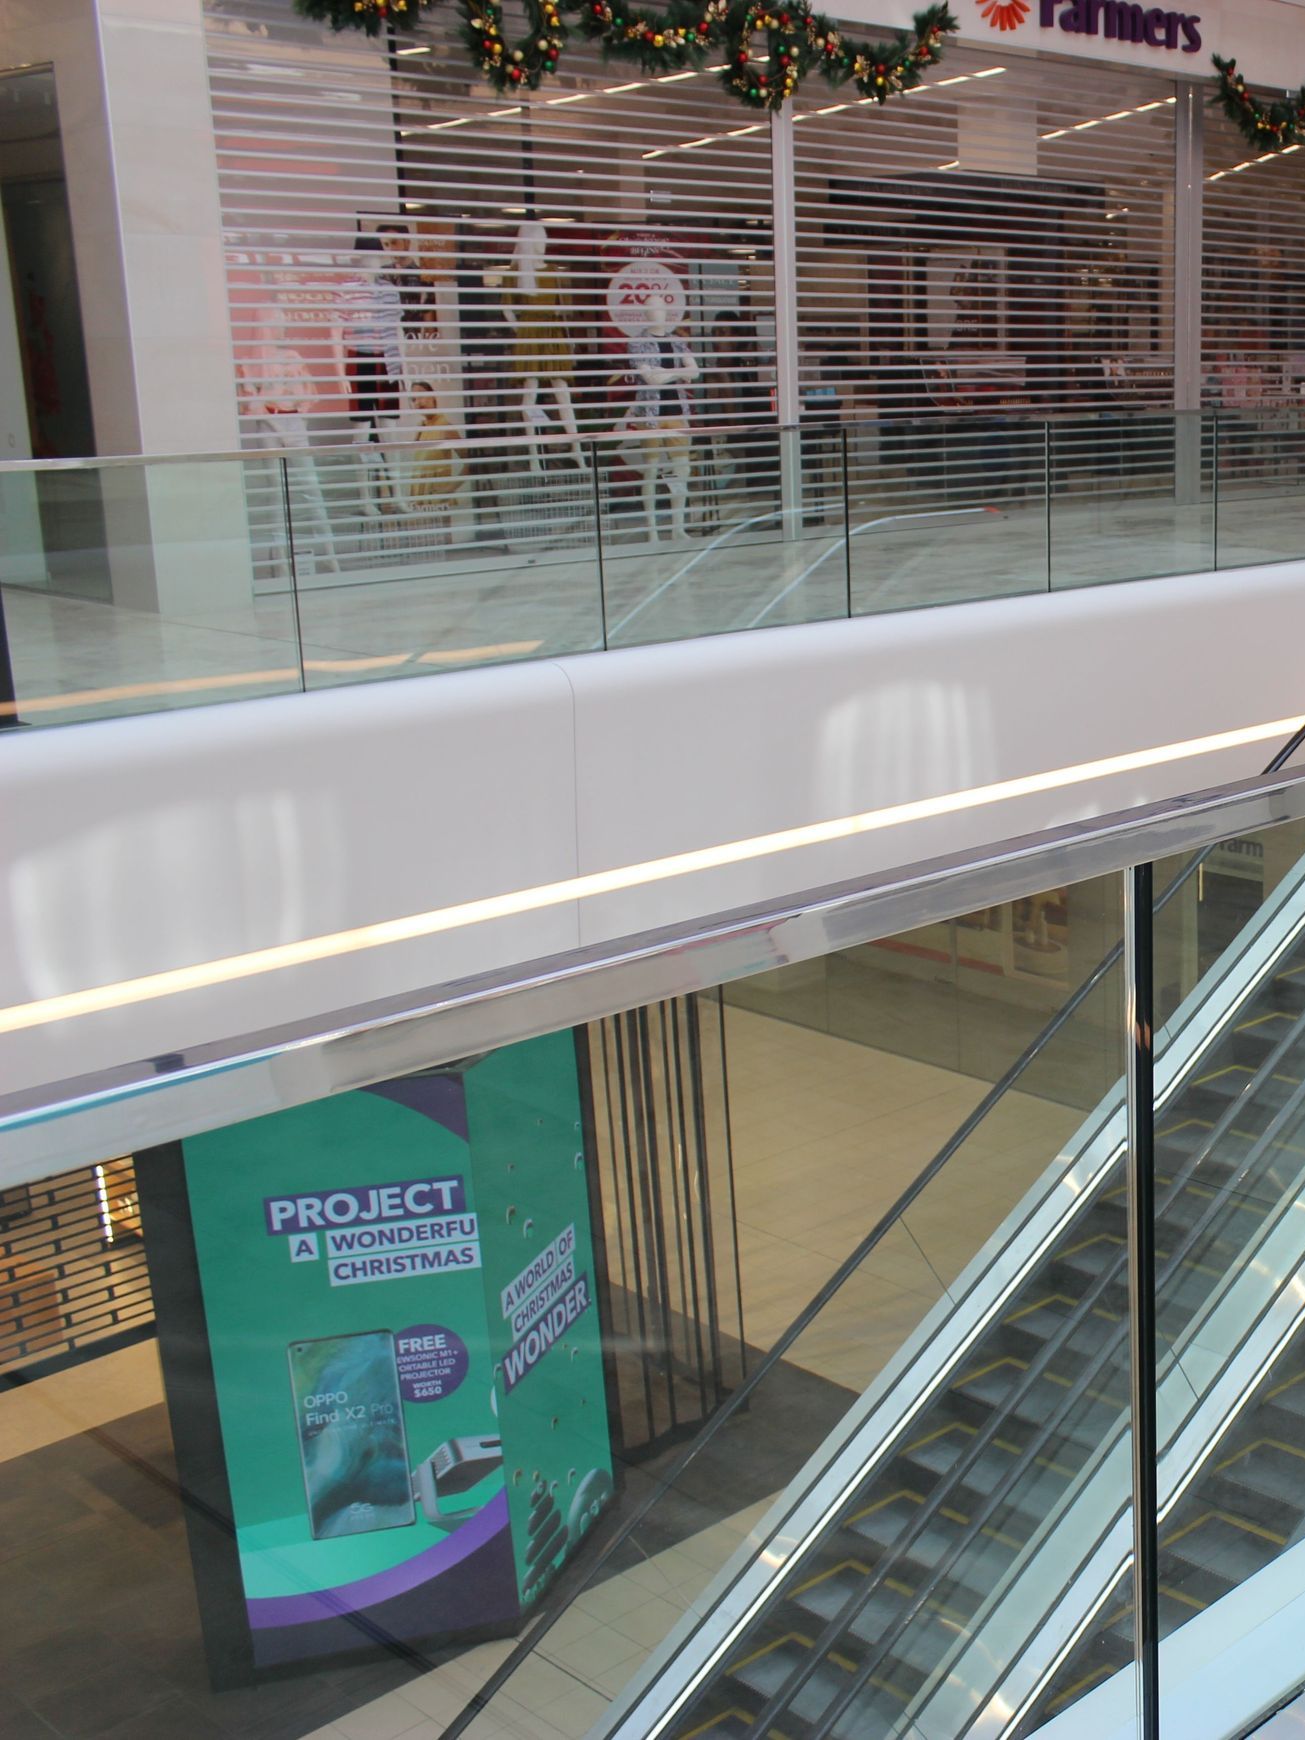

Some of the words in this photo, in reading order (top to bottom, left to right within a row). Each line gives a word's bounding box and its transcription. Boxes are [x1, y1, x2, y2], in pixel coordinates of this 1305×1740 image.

[619, 283, 675, 304] 20%
[269, 1179, 458, 1232] PROJECT
[294, 1239, 314, 1257] A
[331, 1218, 475, 1252] WONDERFU
[333, 1247, 474, 1281] CHRISTMAS
[505, 1291, 514, 1313] A
[514, 1251, 554, 1301] WORLD
[558, 1229, 573, 1257] OF
[513, 1260, 573, 1334] CHRISTMAS
[398, 1333, 447, 1354] FREE
[504, 1279, 592, 1386] WONDER.
[400, 1367, 451, 1380] PROJECTOR
[439, 1358, 456, 1367] LED
[303, 1391, 348, 1409] OPPO
[413, 1386, 442, 1398] $650
[305, 1408, 340, 1426] Find
[345, 1405, 366, 1420] X2
[370, 1402, 394, 1415] Pro
